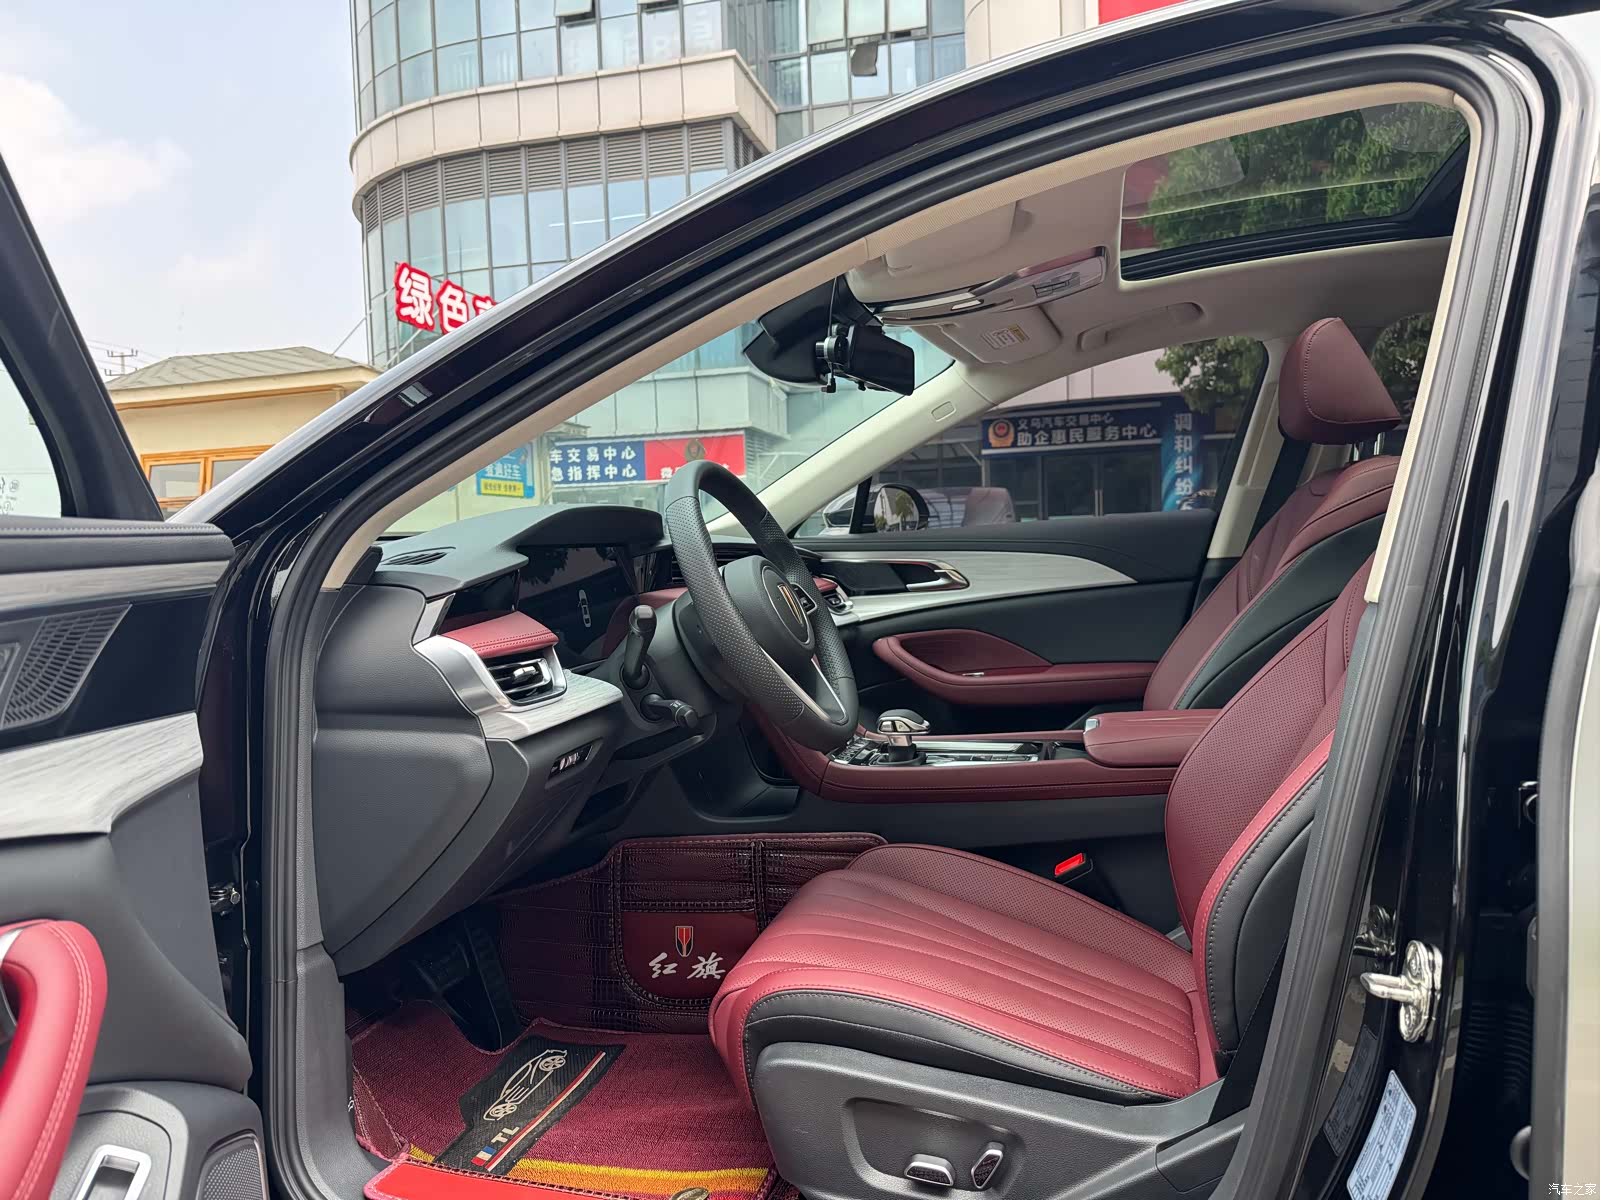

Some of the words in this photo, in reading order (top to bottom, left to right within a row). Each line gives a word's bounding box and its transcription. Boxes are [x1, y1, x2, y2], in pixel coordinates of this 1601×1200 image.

[550, 445, 637, 464] 车交易中心
[550, 463, 638, 482] 急指挥中心
[648, 951, 727, 979] 红旗
[490, 1126, 520, 1143] TL
